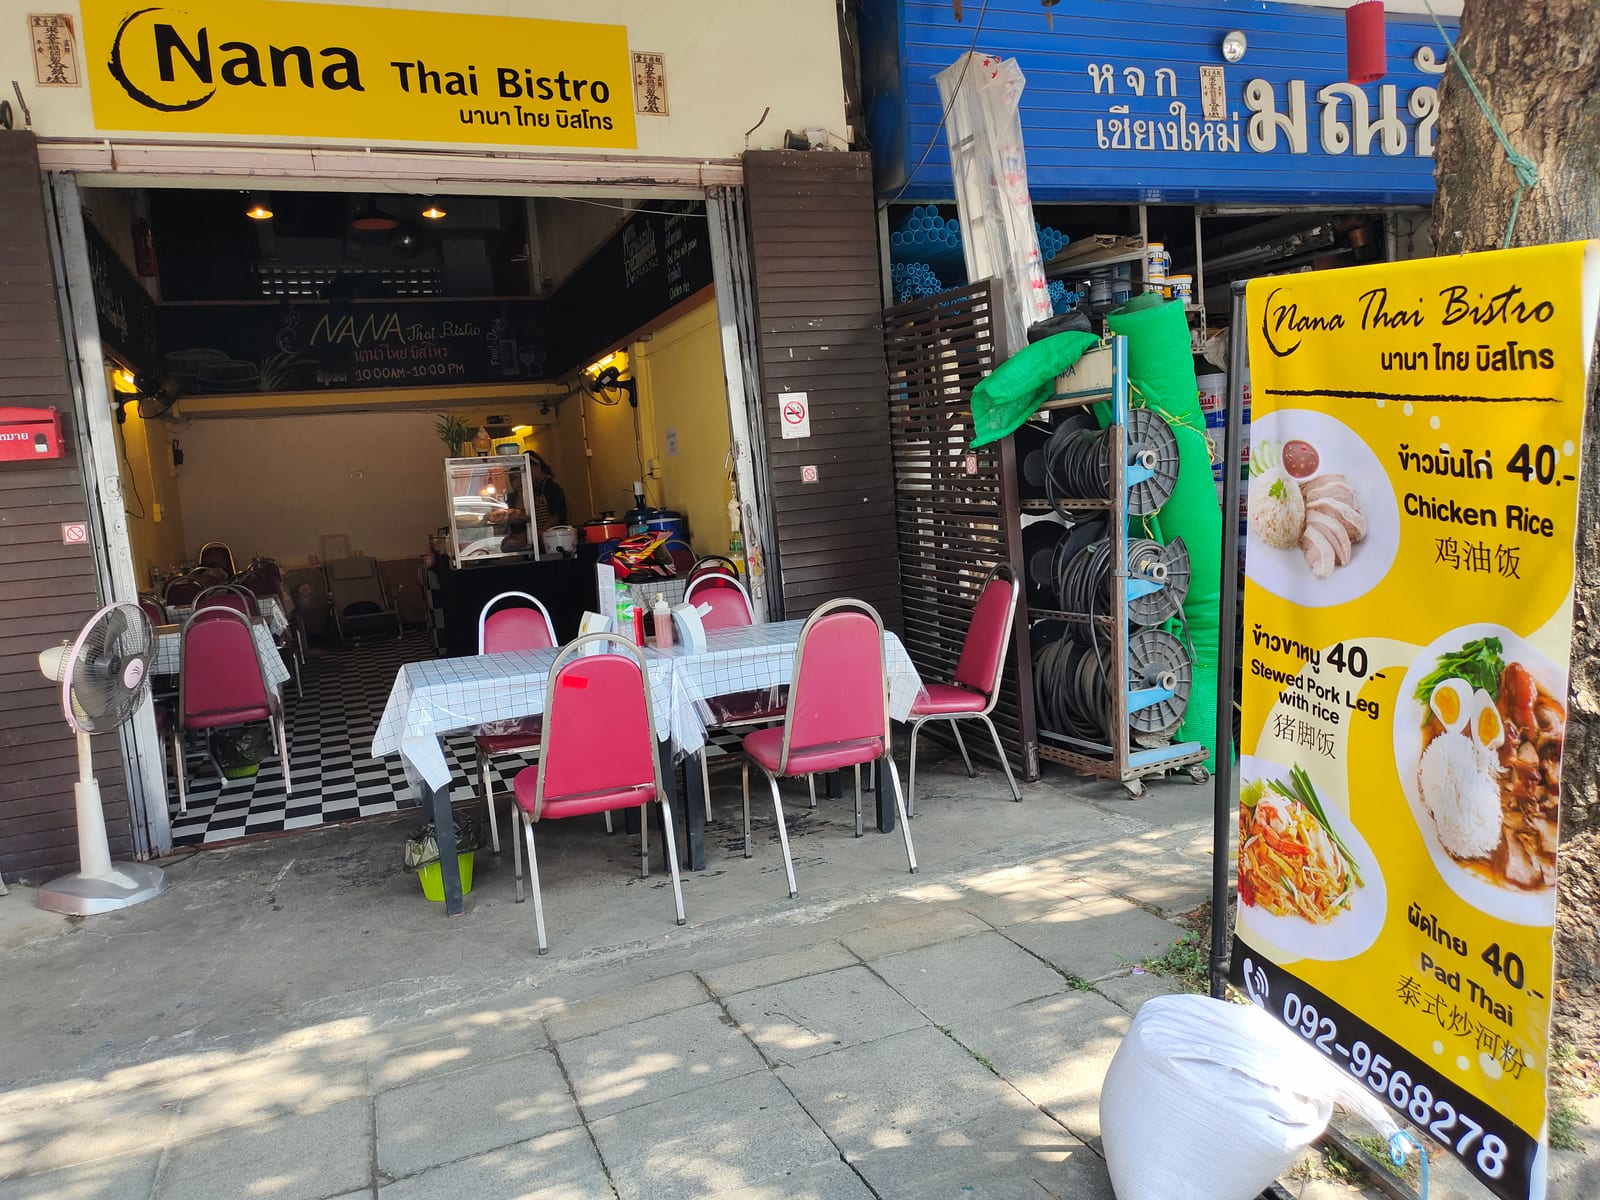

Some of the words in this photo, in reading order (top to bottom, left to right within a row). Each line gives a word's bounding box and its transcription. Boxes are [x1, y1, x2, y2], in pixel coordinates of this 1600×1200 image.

[156, 23, 364, 92] Nana
[391, 61, 479, 98] Thai
[497, 67, 609, 103] Bistro
[310, 311, 406, 348] NANA
[406, 323, 435, 341] Thai
[439, 320, 480, 339] Bistro
[1273, 303, 1345, 333] Nana
[1358, 287, 1424, 331] Thai
[1439, 284, 1554, 326] Bistro
[1381, 350, 1428, 371] นานา
[1432, 342, 1468, 372] ไทย
[1398, 443, 1493, 479] ข้าวมันไก่
[1506, 443, 1575, 486] 40.-
[1403, 492, 1497, 527] Chicken
[1506, 504, 1554, 538] Rice
[1434, 536, 1521, 580] 鸡油饭
[1252, 623, 1321, 674] ข้าวขาหมู
[1326, 642, 1386, 681] 40.-
[1251, 659, 1304, 690] Stewed
[1307, 677, 1340, 705] Pork
[1346, 690, 1380, 720] Leg
[1278, 691, 1309, 713] with
[1312, 702, 1340, 725] rice
[1272, 712, 1337, 760] 猪脚饭
[1407, 901, 1468, 957] ผัดไทย
[1481, 942, 1544, 999] 40.-
[1420, 951, 1461, 993] Pad
[1466, 978, 1513, 1027] Thai
[1395, 974, 1528, 1080] 泰式炒河粉
[1283, 992, 1508, 1179] 092-9568278
